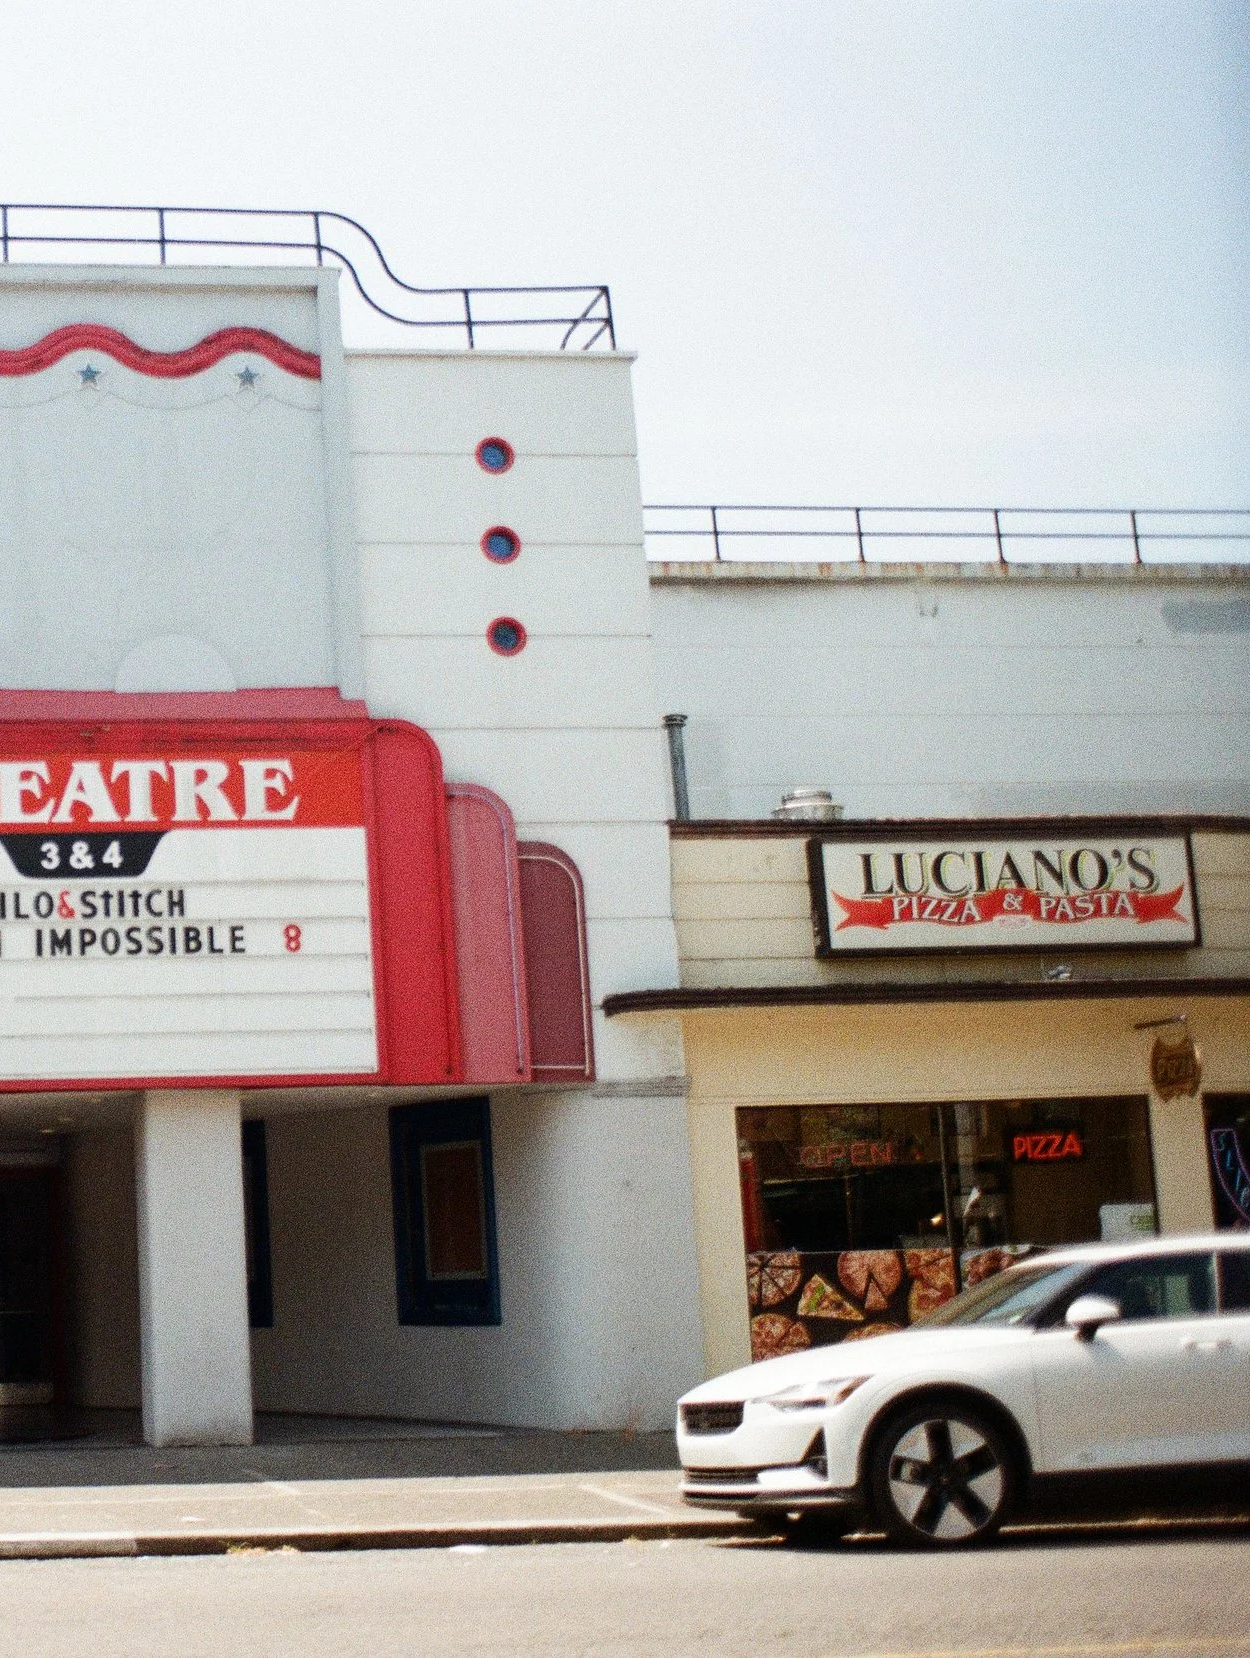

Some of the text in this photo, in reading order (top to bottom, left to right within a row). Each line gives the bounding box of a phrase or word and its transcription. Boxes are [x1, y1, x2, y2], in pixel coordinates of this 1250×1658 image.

[858, 848, 1160, 897] LUCIANO'S
[892, 896, 982, 923] PIZZA
[1003, 893, 1023, 911] &
[1039, 892, 1135, 920] PASTA
[35, 926, 246, 957] IMPOSSIBLE
[284, 924, 302, 953] 8
[800, 1140, 894, 1168] OPEN
[1013, 1132, 1082, 1161] PIZZA
